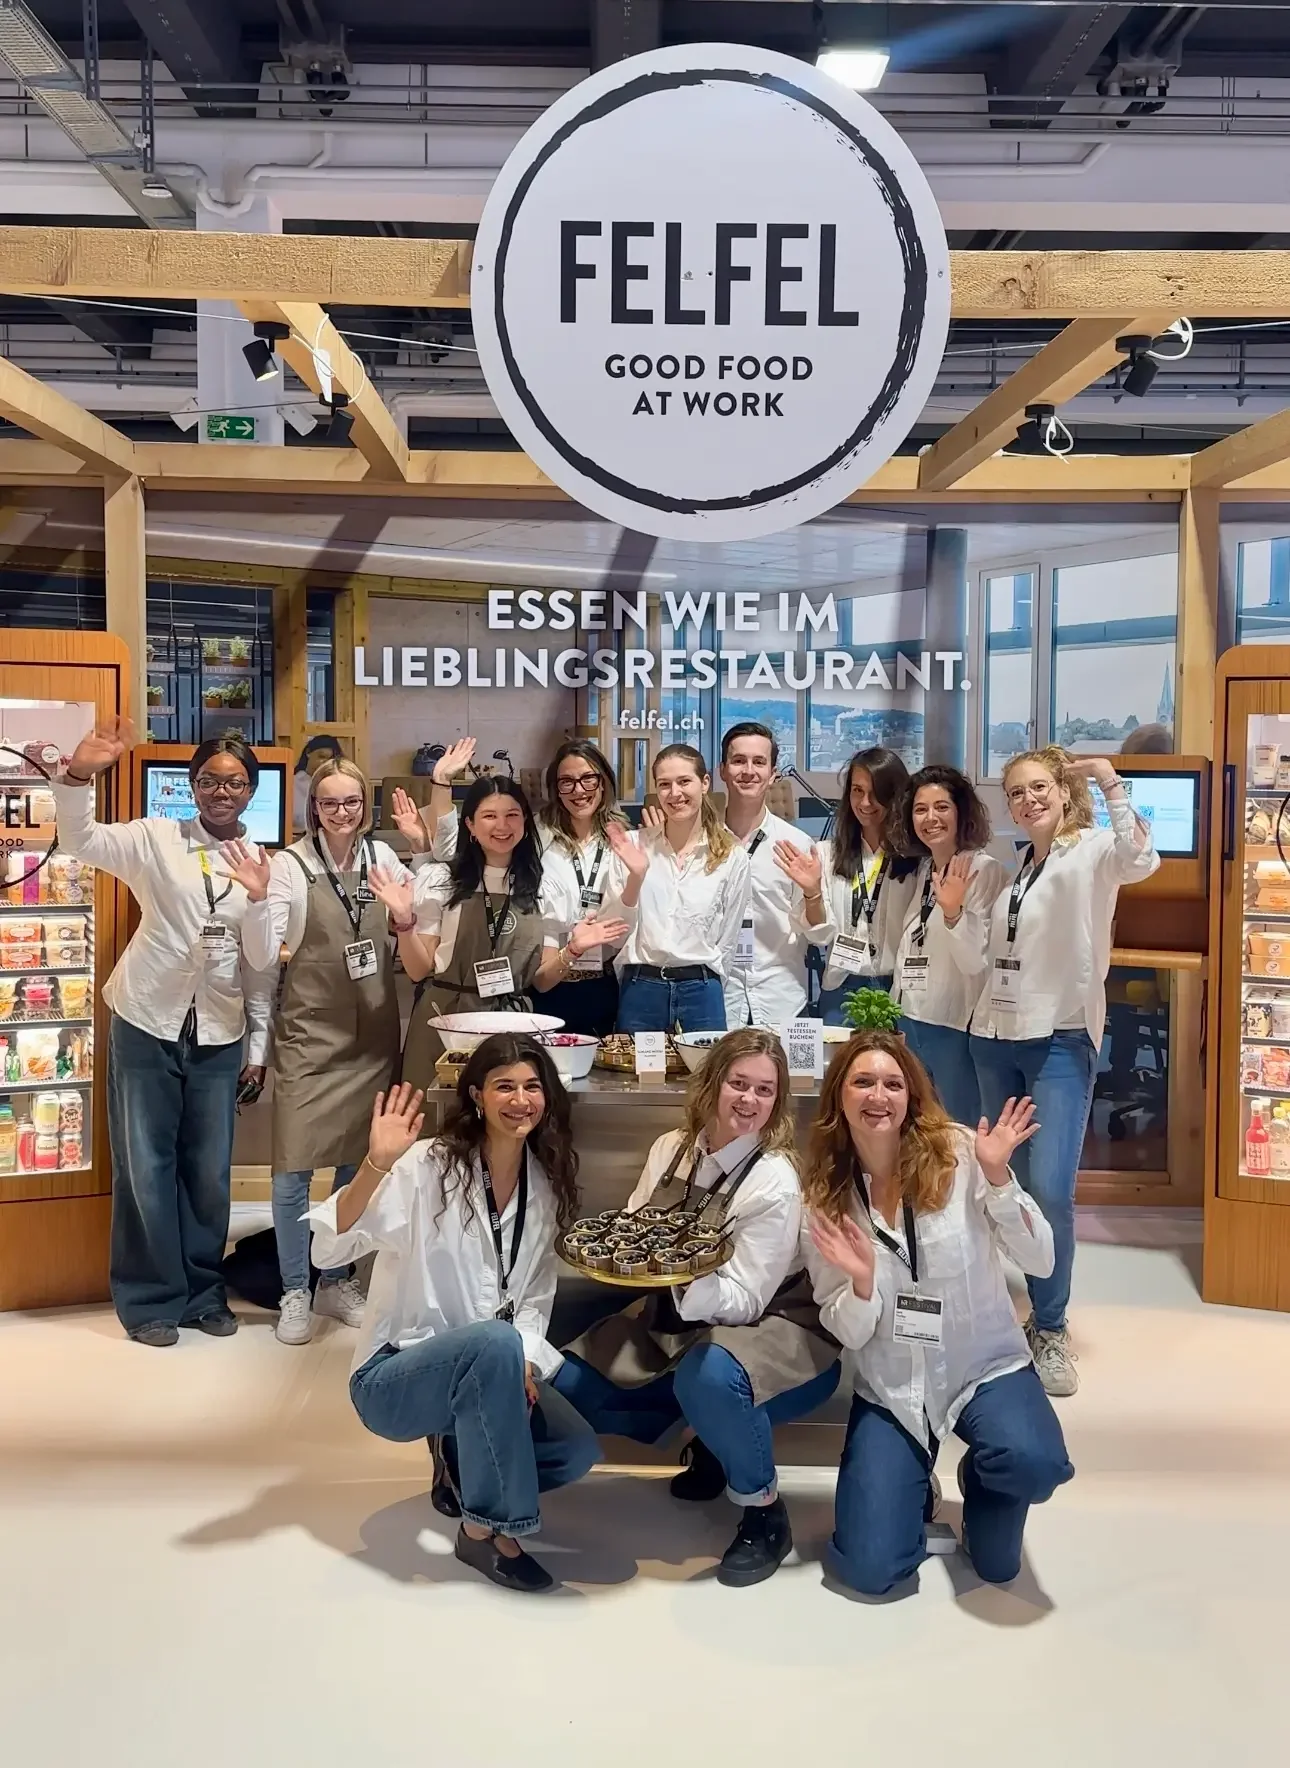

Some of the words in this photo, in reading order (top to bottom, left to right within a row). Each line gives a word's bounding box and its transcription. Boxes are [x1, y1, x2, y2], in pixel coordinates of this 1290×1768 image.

[560, 220, 860, 327] FELFEL
[604, 353, 706, 380] GOOD
[718, 355, 813, 381] FOOD
[632, 390, 673, 416] AT
[682, 391, 784, 417] WORK
[487, 590, 647, 631] ESSEN
[664, 591, 761, 632] WIE
[778, 592, 840, 633] IM
[354, 645, 973, 692] LIEBLINGSRESTAURANT.
[619, 708, 705, 731] felfel.ch
[0, 794, 41, 829] EL
